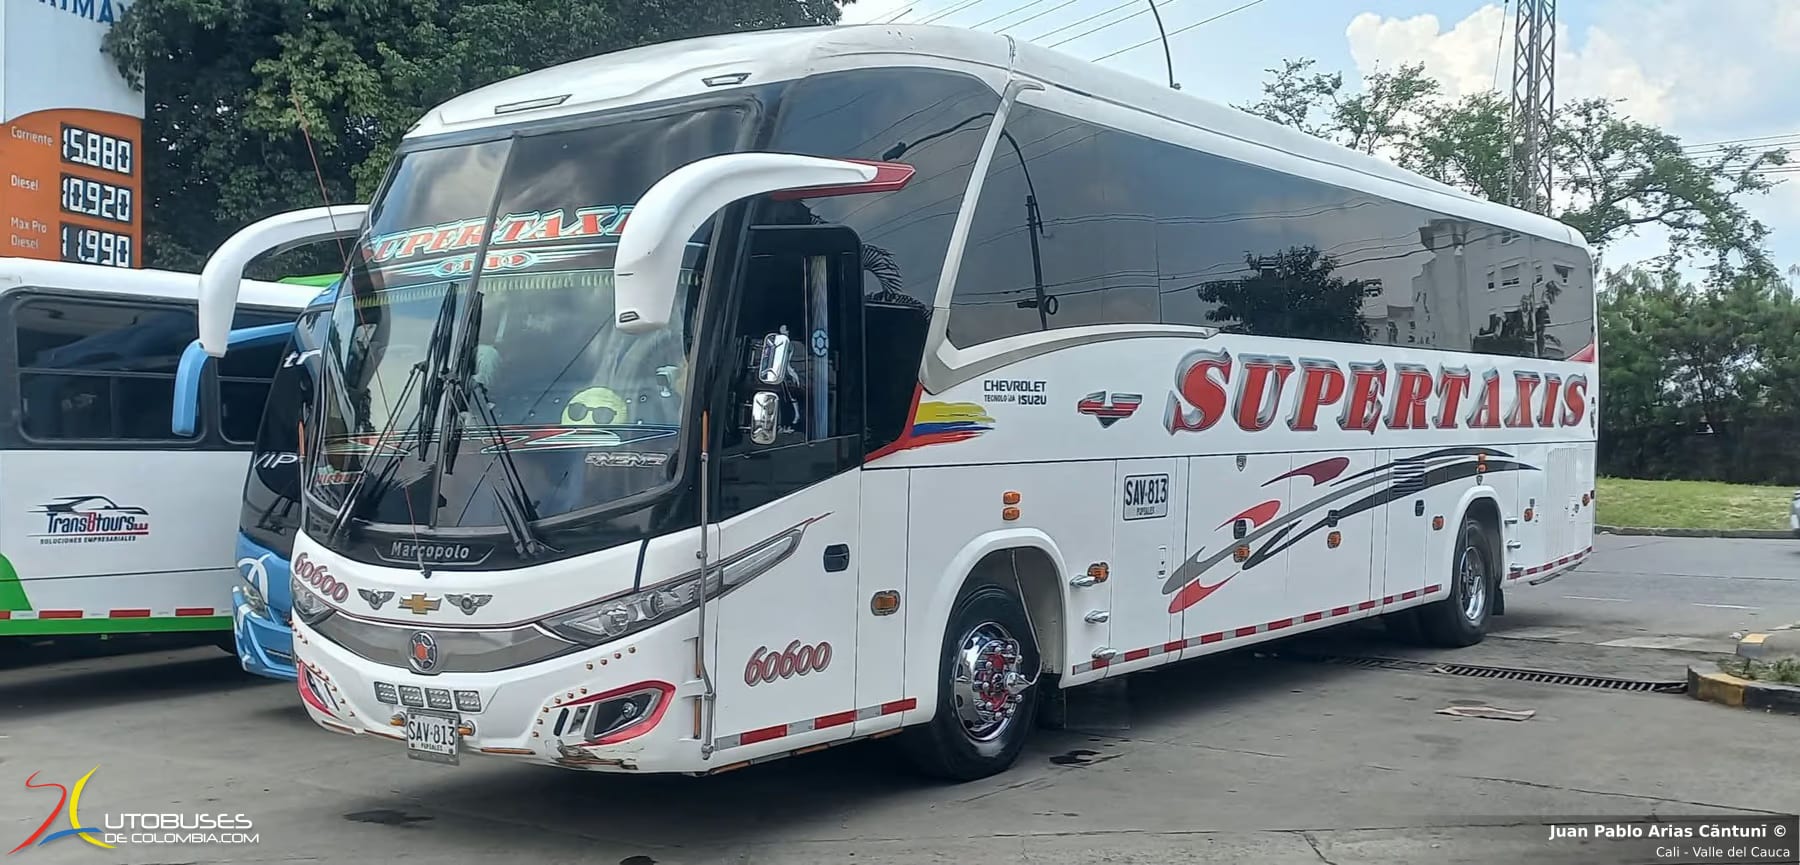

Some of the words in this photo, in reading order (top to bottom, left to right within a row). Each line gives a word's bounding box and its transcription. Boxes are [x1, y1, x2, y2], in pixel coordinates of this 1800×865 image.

[11, 126, 53, 147] Corriente
[62, 127, 131, 173] 15.880
[11, 175, 38, 190] Diesel
[62, 178, 131, 221] 10.920
[11, 217, 29, 230] Max
[32, 220, 47, 233] Pro
[11, 235, 38, 249] Diesel
[62, 226, 130, 268] 11.990
[984, 380, 1047, 393] CHEVROLET
[1163, 346, 1589, 437] SUPERTAXIS
[1018, 394, 1047, 405] ISUZU
[391, 541, 470, 559] Marcopolo
[294, 552, 349, 604] 60600
[744, 639, 833, 687] 60600
